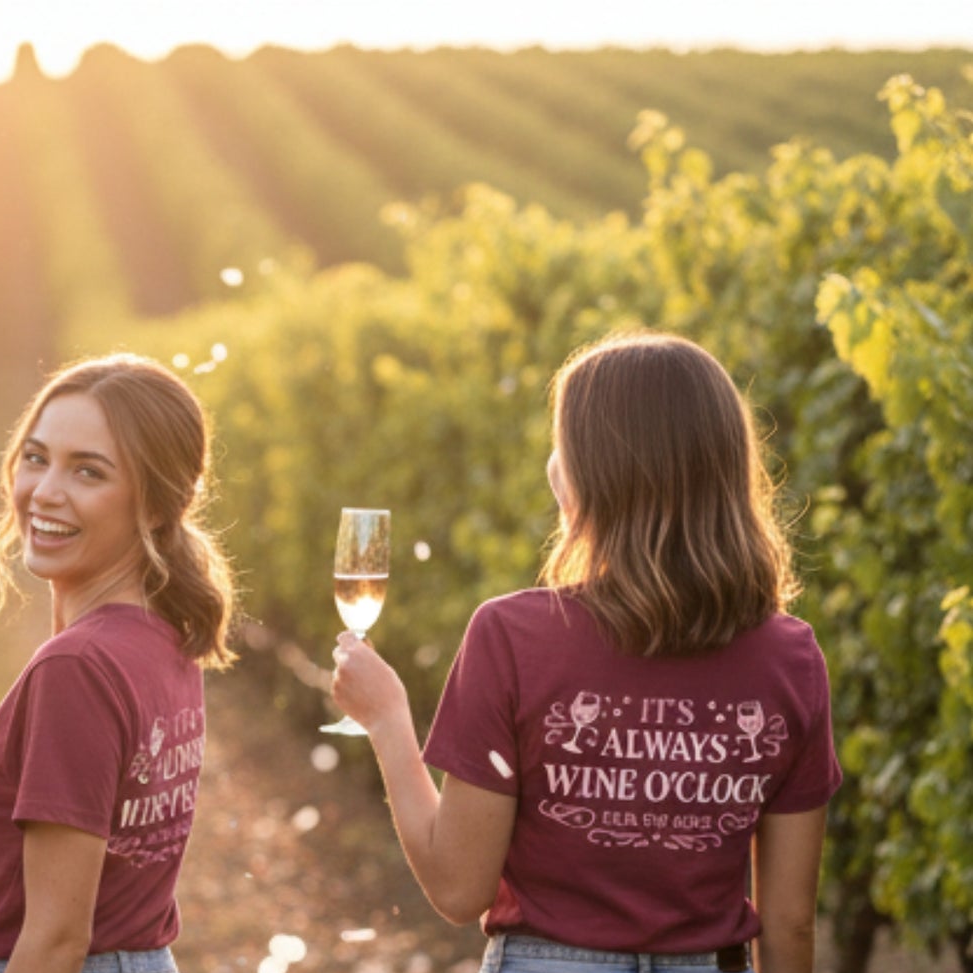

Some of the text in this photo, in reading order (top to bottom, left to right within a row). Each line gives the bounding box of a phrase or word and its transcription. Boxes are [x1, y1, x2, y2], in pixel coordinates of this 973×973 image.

[640, 698, 695, 725] IT'S
[601, 728, 729, 763] ALWAYS
[543, 763, 771, 804] WINE O'CLOCK
